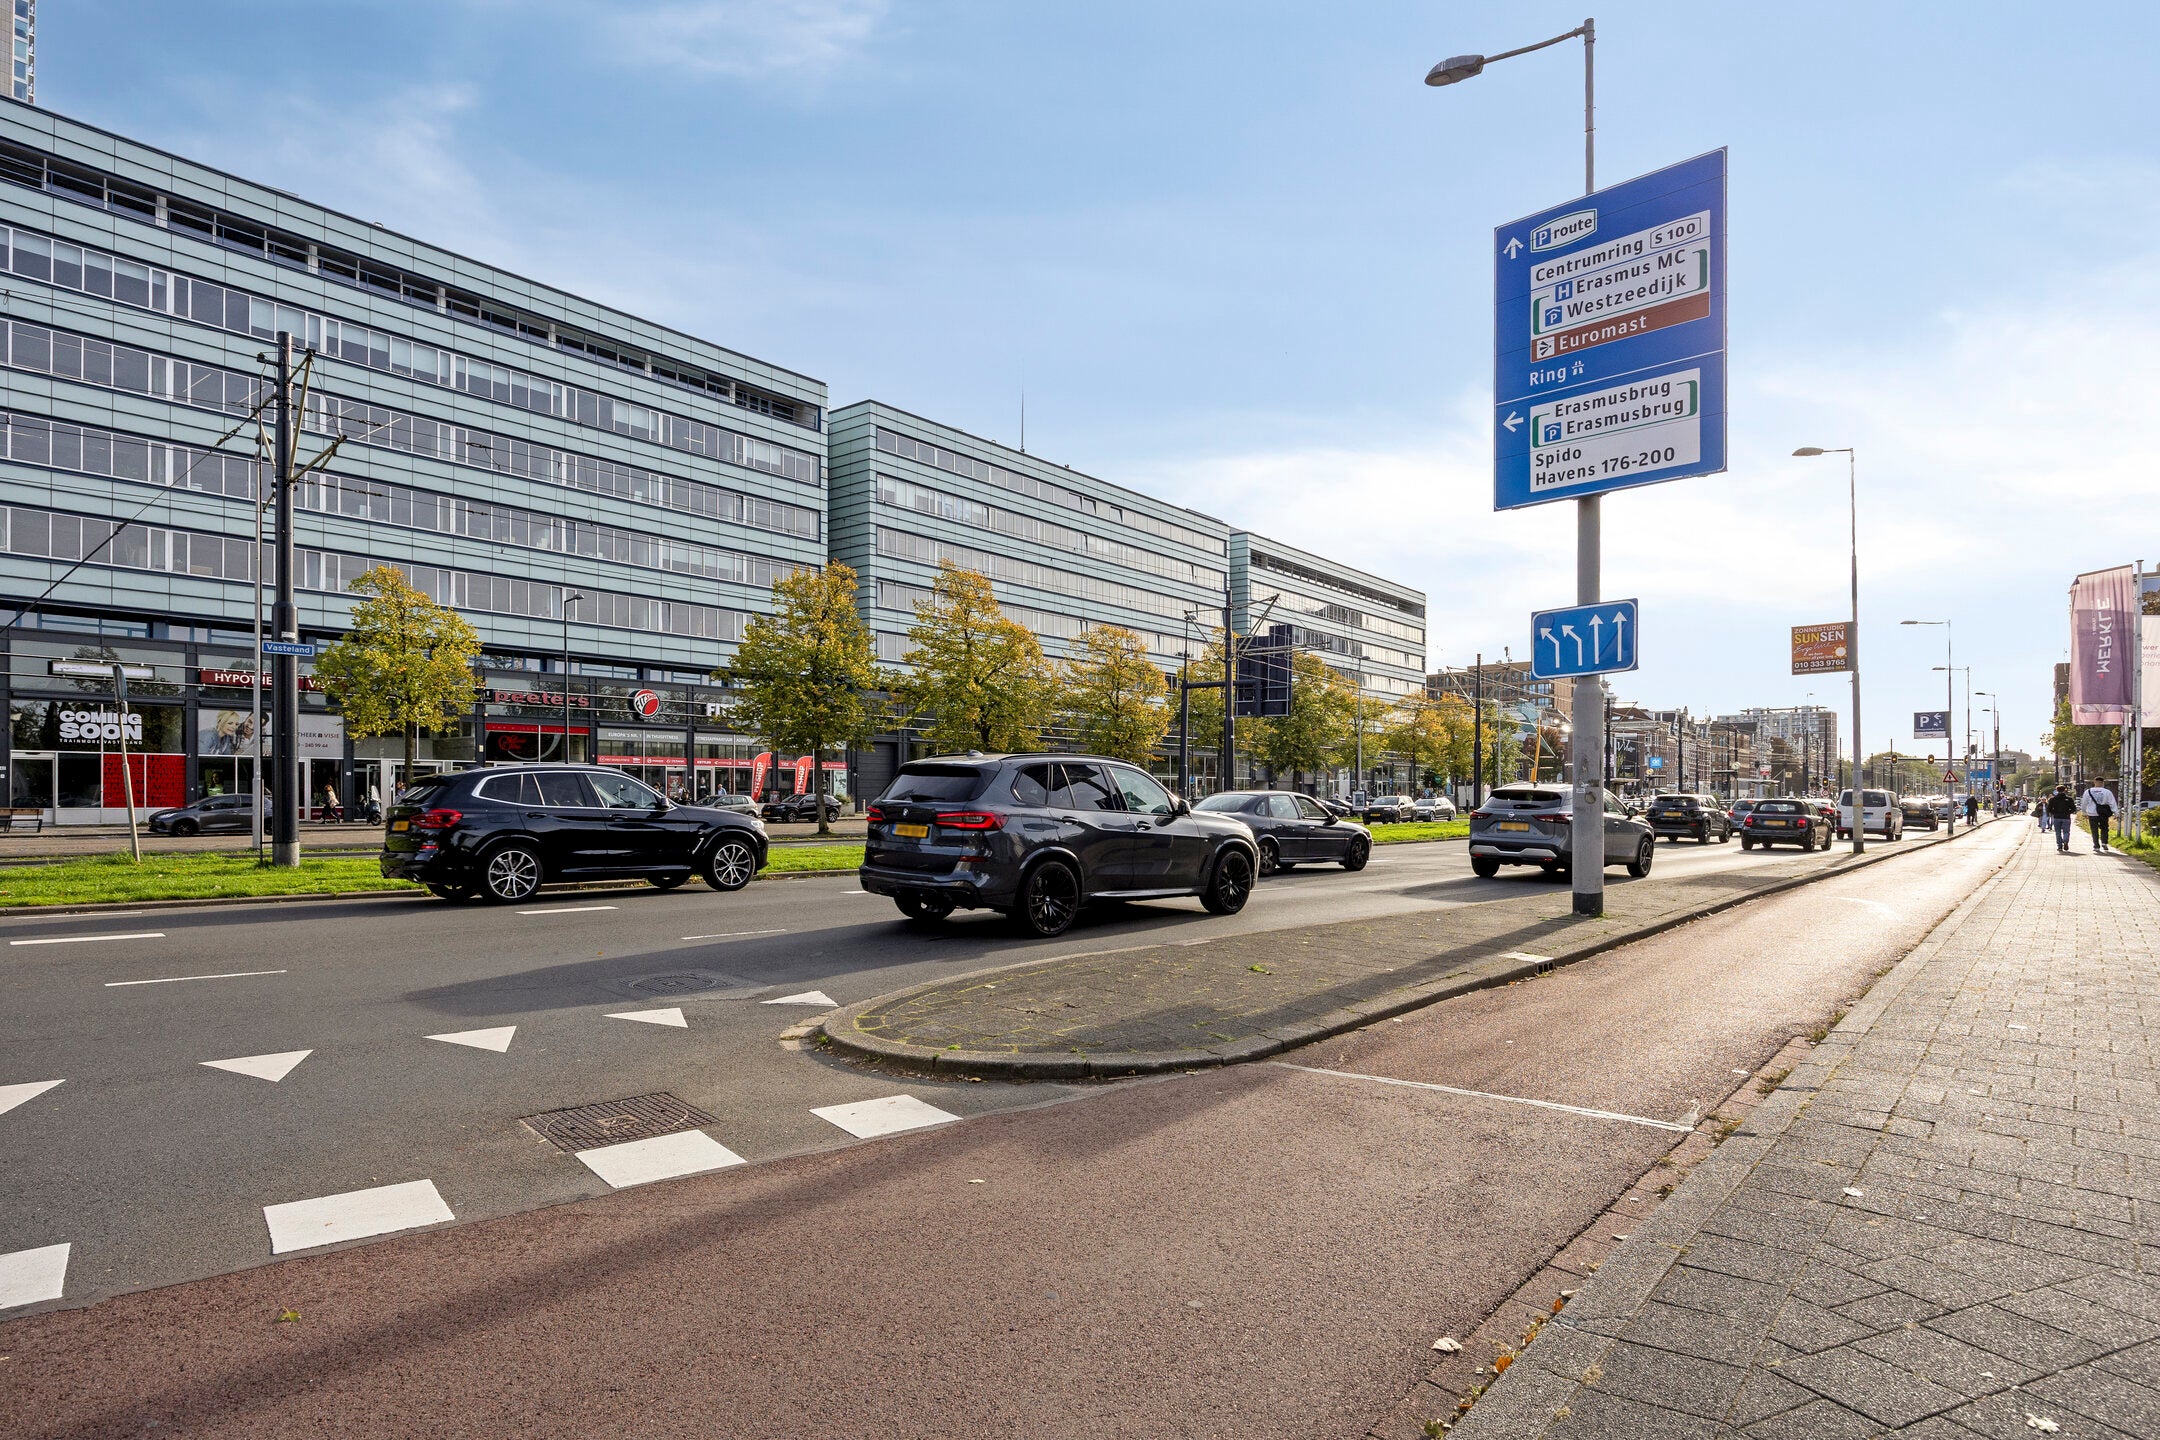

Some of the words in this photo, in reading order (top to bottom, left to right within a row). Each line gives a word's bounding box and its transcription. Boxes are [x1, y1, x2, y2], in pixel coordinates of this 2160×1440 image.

[1553, 217, 1593, 238] route
[1655, 231, 1664, 245] S
[1666, 222, 1697, 241] 100
[1535, 237, 1644, 282] Centrumring
[1576, 261, 1650, 293] Erasmus
[1657, 249, 1686, 270] MC
[1567, 273, 1687, 318] Westzeedijk
[1559, 315, 1647, 350] Euromast
[1529, 365, 1566, 386] Ring
[1555, 380, 1671, 418] Erasmusbrug
[1567, 397, 1684, 435] Erasmusbrug
[1535, 448, 1582, 468] Spido
[1536, 464, 1596, 486] Havens
[1601, 447, 1675, 474] 176-200
[1794, 624, 1845, 634] ZONNESTUDIO
[1794, 630, 1844, 644] SUNSEN
[266, 643, 311, 654] Vasteland
[1794, 661, 1809, 669] 010
[1810, 660, 1825, 668] 333
[1826, 658, 1846, 667] 9765
[494, 691, 590, 707] peeters
[59, 710, 142, 725] COMING
[59, 722, 142, 740] SOON
